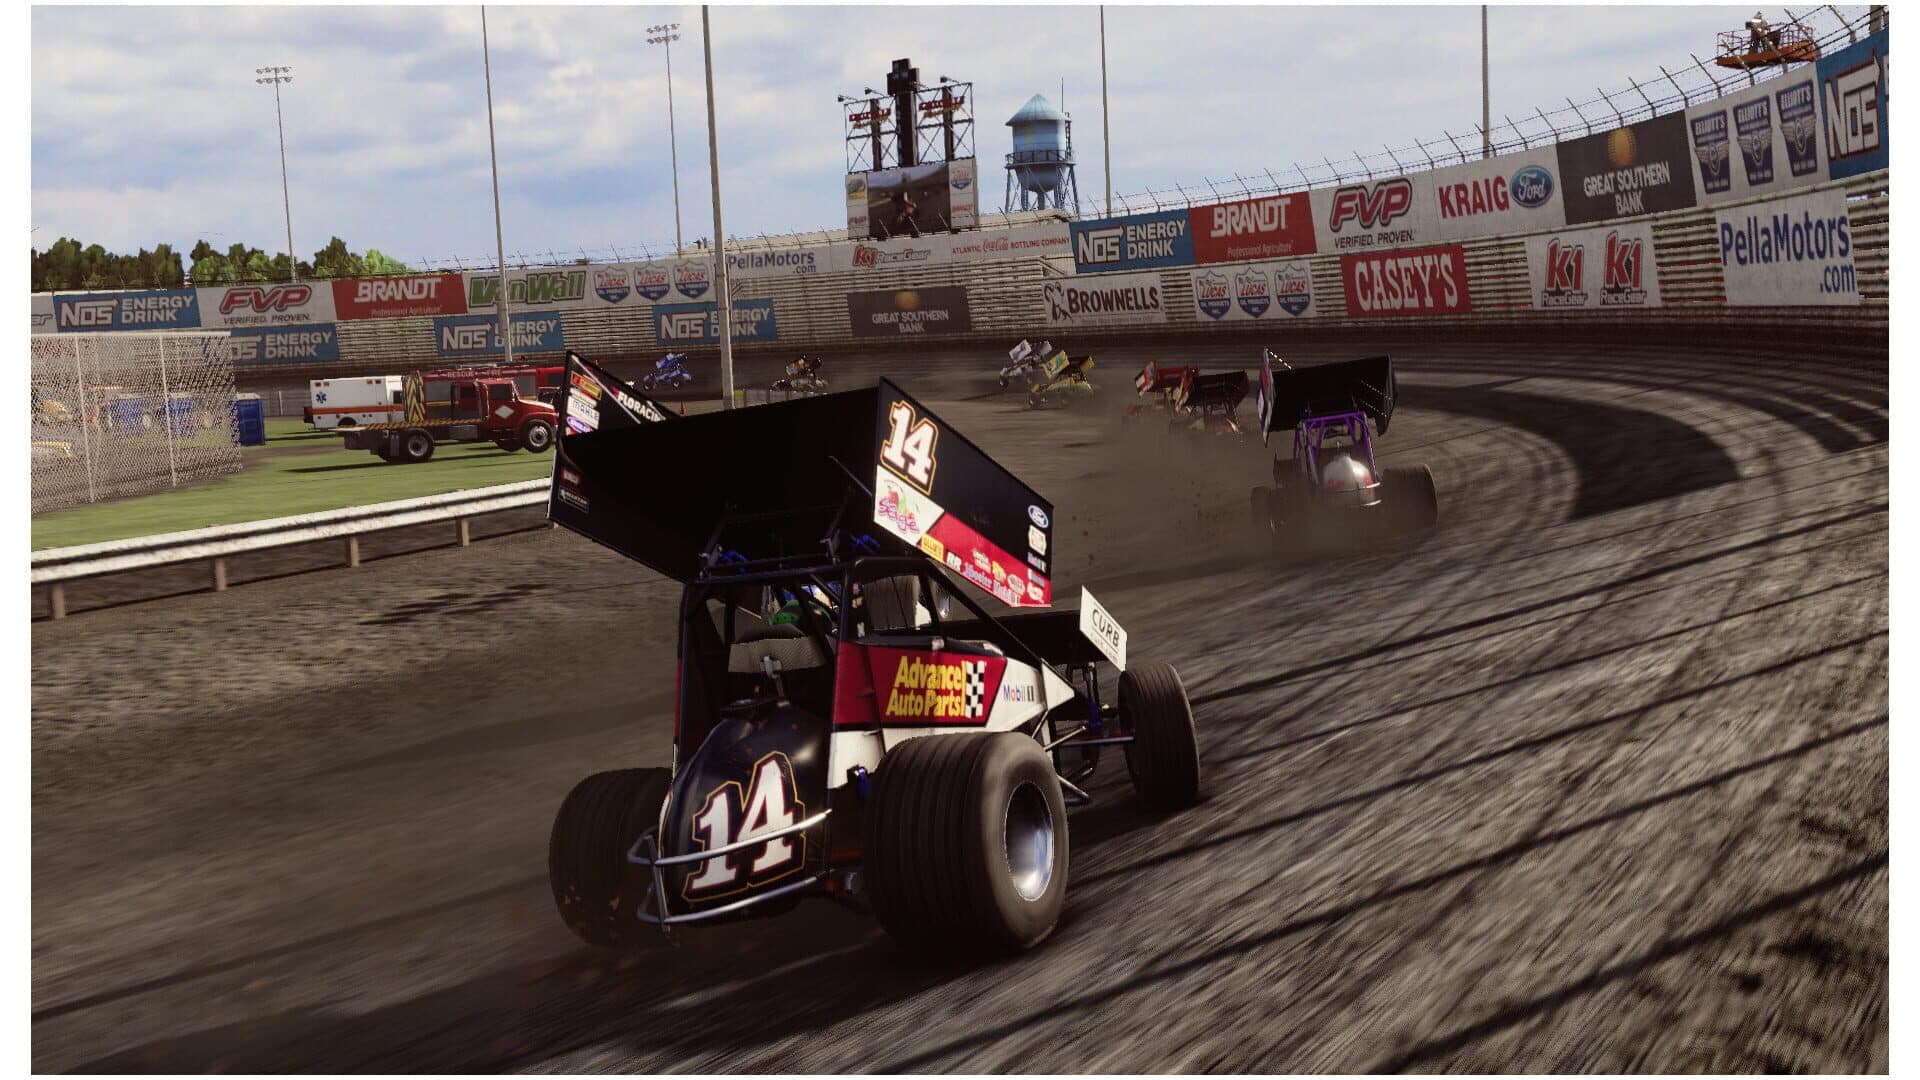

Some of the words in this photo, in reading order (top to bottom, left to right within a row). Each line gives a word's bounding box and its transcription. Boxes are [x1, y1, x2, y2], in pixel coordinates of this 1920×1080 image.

[1824, 48, 1880, 160] NOS
[1583, 174, 1615, 197] GREAT
[1617, 161, 1671, 192] SOUTHERN
[1330, 178, 1412, 232] FVP
[1439, 176, 1509, 219] KRAIG
[1518, 173, 1545, 200] Ford
[1615, 190, 1645, 216] BANK
[1210, 198, 1291, 237] BRANDT
[1078, 225, 1123, 264] NOS
[1127, 219, 1186, 242] ENERGY
[1127, 240, 1174, 260] DRINK
[1335, 236, 1374, 248] VERIFIED.
[1720, 211, 1849, 266] PellaMotors
[728, 251, 815, 270] PellaMotors
[793, 264, 817, 275] .com
[354, 277, 442, 303] BRANDT
[1201, 286, 1226, 298] LUCAS
[1241, 283, 1265, 296] LUCAS
[1280, 280, 1306, 293] LUCAS
[1355, 253, 1458, 312] CASEY'S
[1820, 264, 1855, 294] .com
[59, 297, 118, 327] NOS
[122, 294, 193, 312] ENERGY
[220, 284, 312, 315] FVP
[1066, 286, 1160, 314] BROWNELLS
[122, 310, 177, 323] DRINK
[661, 310, 708, 340] NOS
[711, 308, 770, 323] EERGY
[711, 322, 758, 337] DINK
[872, 312, 900, 324] GREAT
[901, 309, 949, 322] SOUTHERN
[899, 321, 925, 333] BANK
[265, 331, 332, 346] ENERGY
[442, 322, 492, 350] NOS
[265, 345, 318, 359] DRINK
[882, 402, 938, 492] 14
[1092, 608, 1120, 647] CURB
[894, 655, 962, 690] Advance
[885, 688, 923, 717] Auto
[924, 689, 961, 717] Parts
[1003, 685, 1025, 702] Mobil
[686, 753, 801, 897] 14
